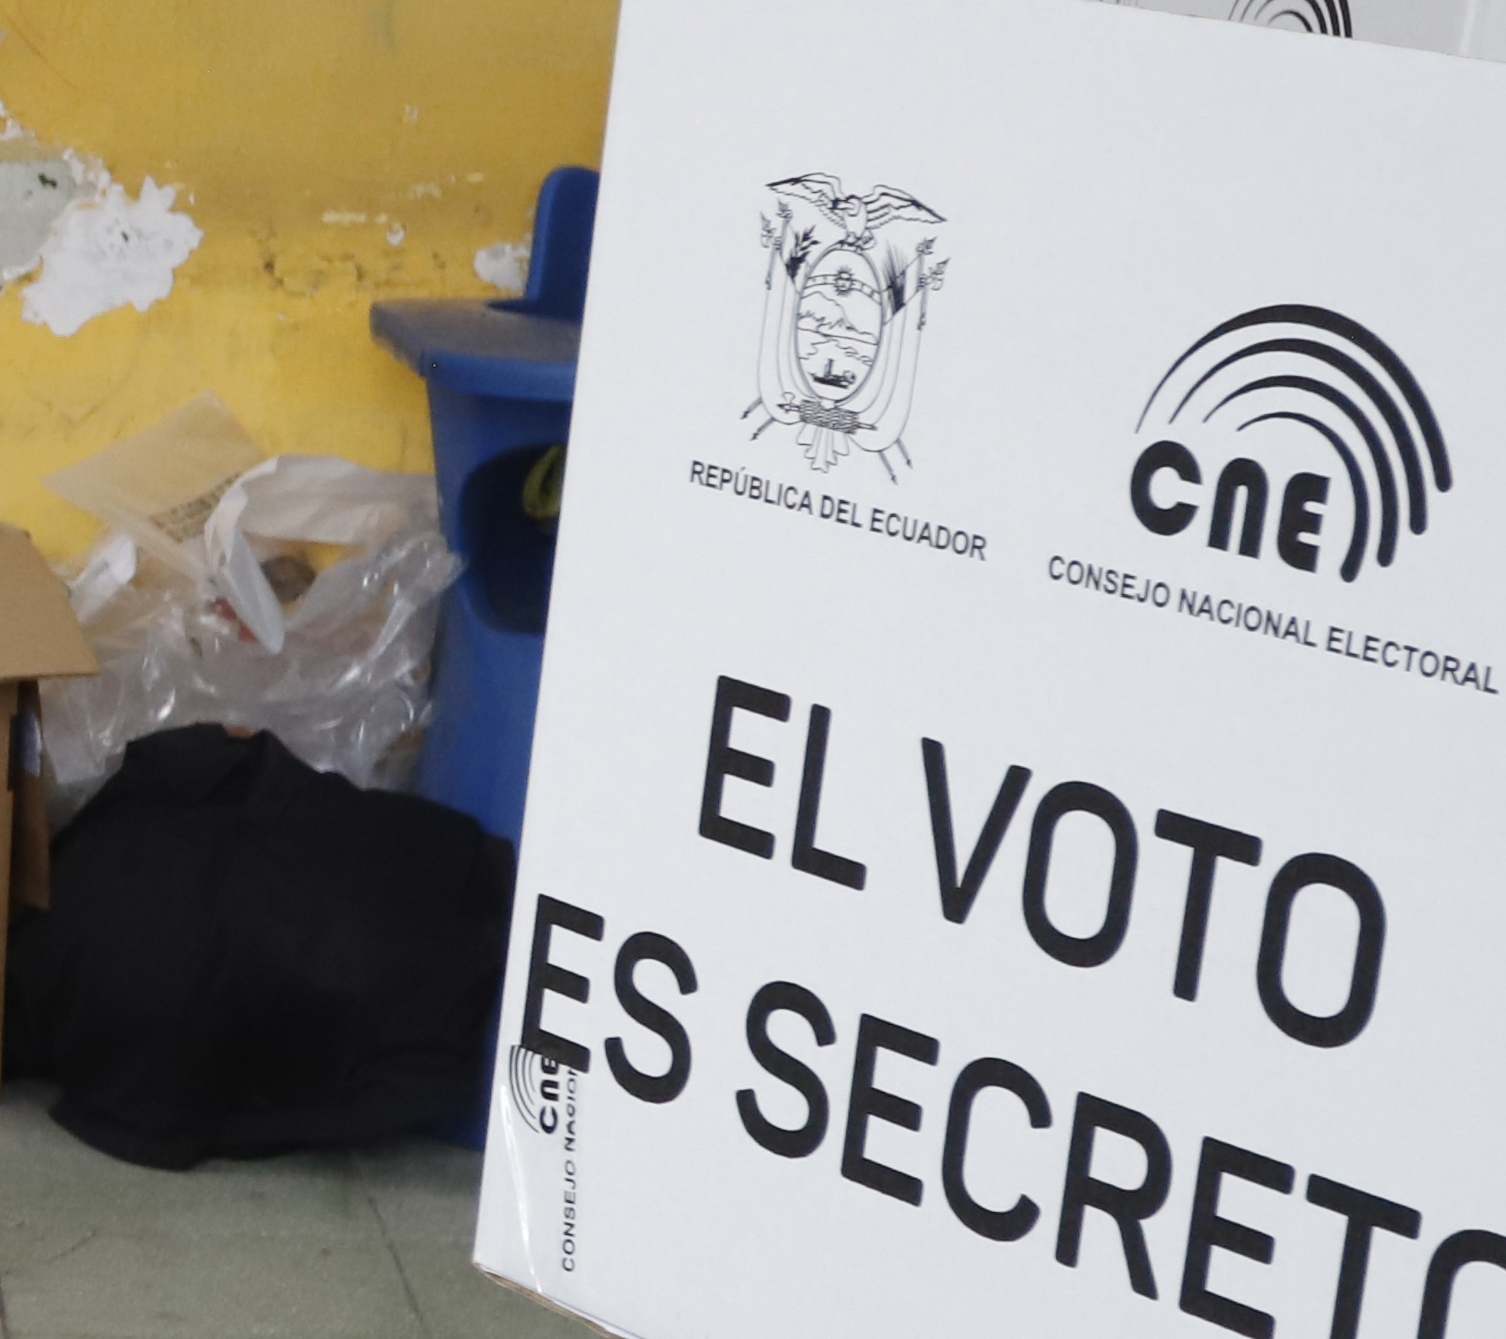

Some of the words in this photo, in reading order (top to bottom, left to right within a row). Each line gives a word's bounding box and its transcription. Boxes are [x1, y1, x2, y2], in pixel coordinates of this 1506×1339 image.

[689, 459, 814, 516] REPÚBLICA
[819, 494, 864, 529] DEL
[869, 507, 988, 562] ECUADOR
[1047, 554, 1171, 608] CONSEJO
[1177, 587, 1318, 649] NACIONAL
[1326, 624, 1500, 695] ELECTORAL
[697, 674, 867, 892] EL
[920, 737, 1387, 1049] VOTO
[520, 892, 699, 1104] ES
[561, 1159, 578, 1273] CONSEJO
